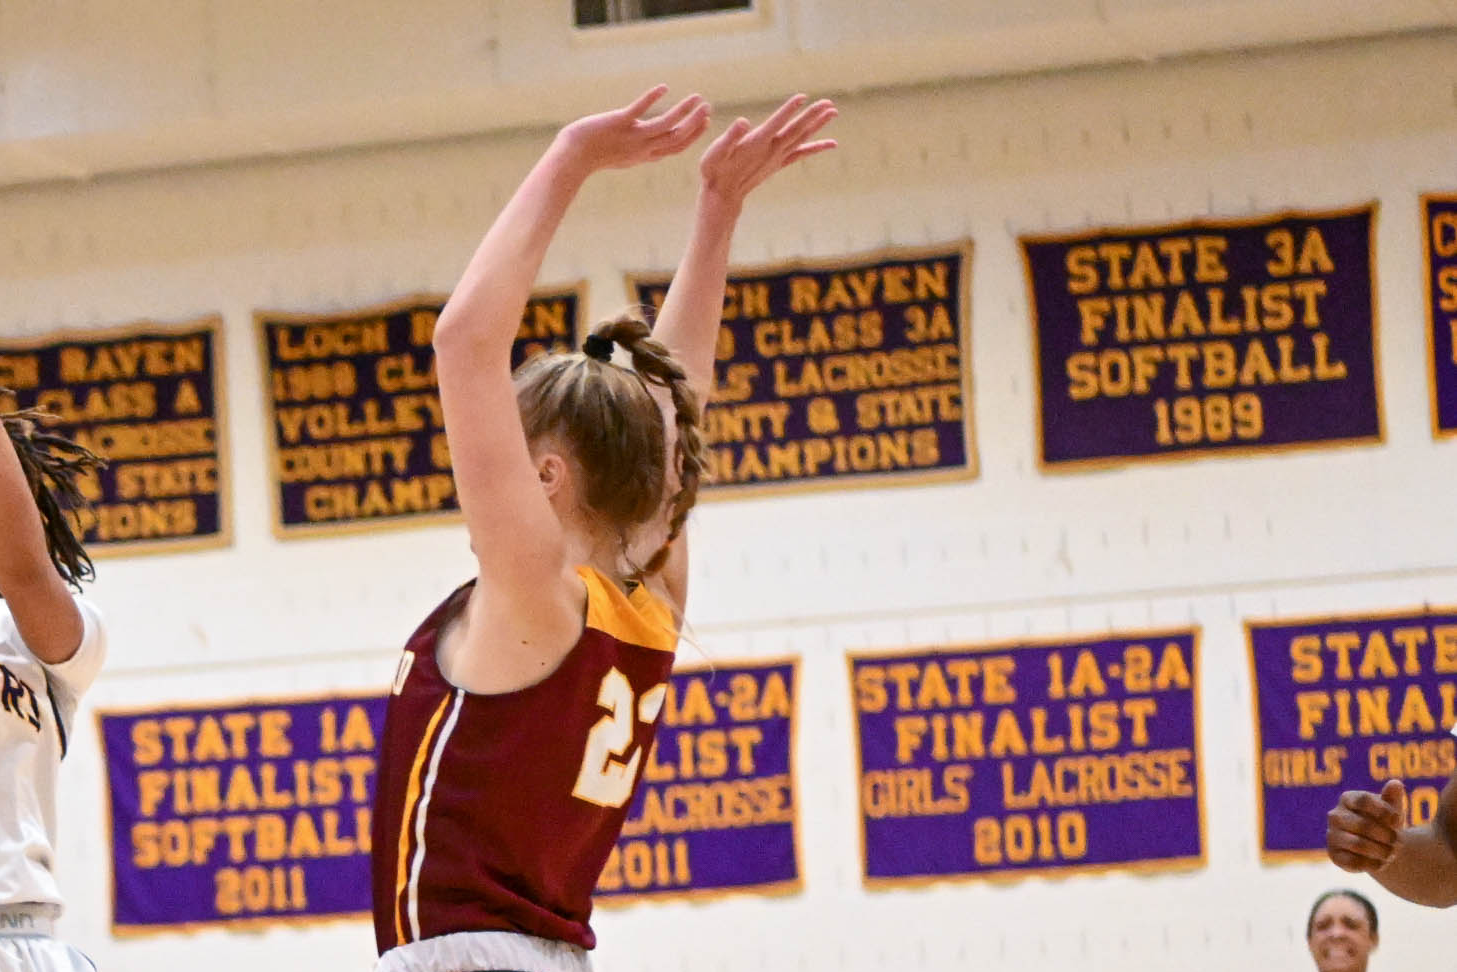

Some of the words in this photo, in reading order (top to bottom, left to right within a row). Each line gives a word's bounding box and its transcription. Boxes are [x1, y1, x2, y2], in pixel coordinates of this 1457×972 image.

[1065, 234, 1229, 295] STATE
[1264, 226, 1335, 278] 3A
[790, 264, 950, 315] RAVEN
[1077, 279, 1329, 347] FINALIST
[753, 310, 884, 358] CLASS
[903, 303, 953, 343] 3A
[1065, 331, 1348, 401] SOFTBALL
[855, 384, 961, 430] STATE
[1153, 392, 1265, 446] 1989
[703, 428, 941, 482] HAMPIONS
[855, 656, 1017, 713] STATE
[131, 710, 293, 767] STATE
[318, 704, 376, 754] 1A
[894, 698, 1158, 764] FINALIST
[137, 755, 377, 817] FINALIST
[1001, 748, 1193, 810] LACROSSE
[973, 810, 1089, 866] 2010
[214, 864, 307, 914] 2011
